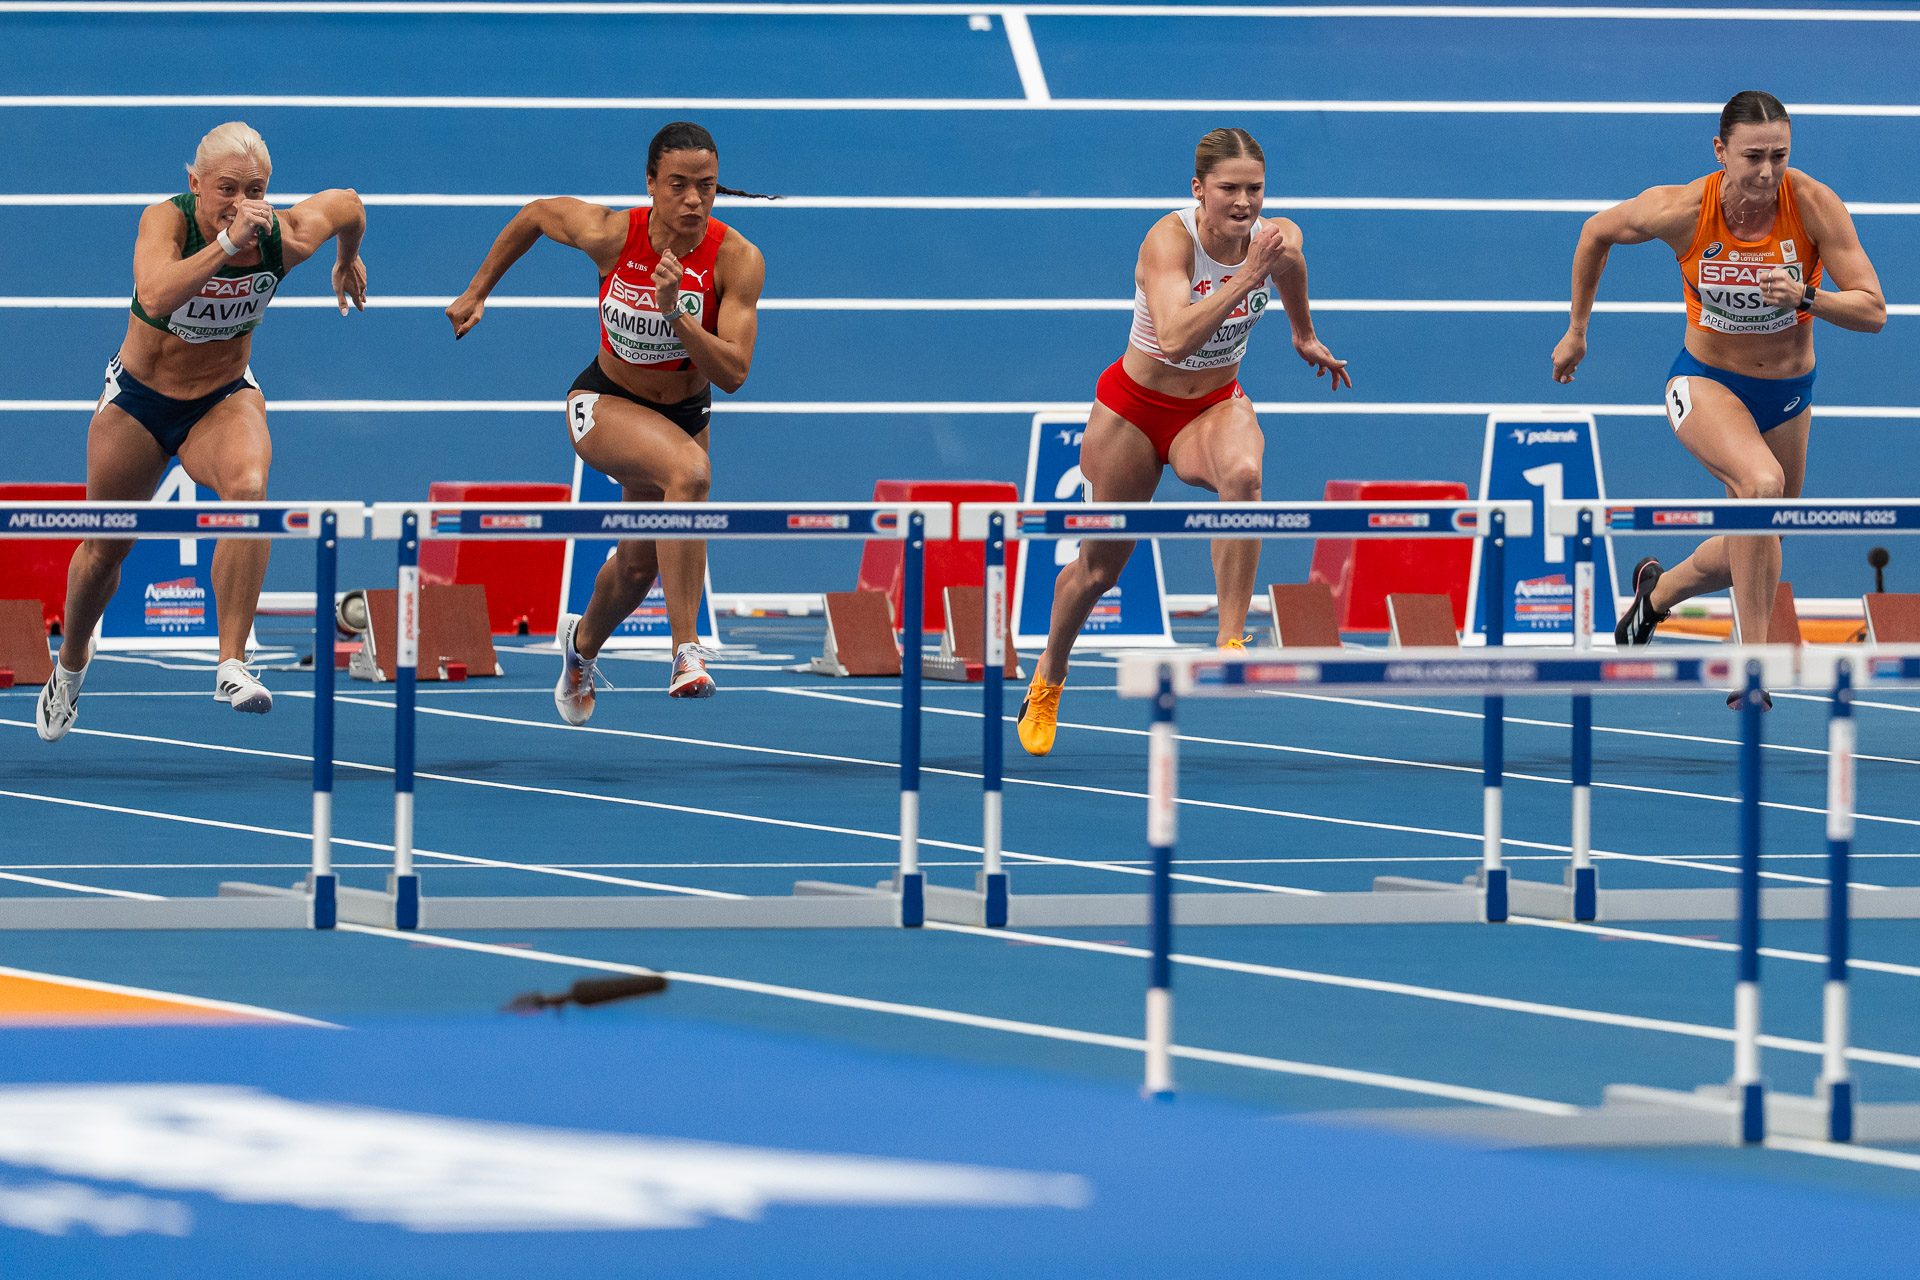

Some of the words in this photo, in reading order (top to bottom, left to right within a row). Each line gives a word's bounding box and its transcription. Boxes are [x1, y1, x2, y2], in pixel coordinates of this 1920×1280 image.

[634, 263, 648, 272] UBS
[201, 280, 250, 296] PAR
[612, 281, 660, 309] SPA
[1193, 280, 1211, 295] 4F
[187, 299, 259, 321] LAVIN
[1726, 313, 1745, 322] RUN
[603, 302, 677, 338] KAMBUN
[1704, 314, 1770, 332] APELDOORN
[1772, 314, 1795, 330] 2025
[194, 327, 214, 335] RUN
[621, 337, 640, 349] RUN
[667, 351, 687, 359] 202
[1195, 350, 1215, 358] RUN
[1672, 389, 1685, 419] 3
[575, 401, 586, 433] 5
[1522, 462, 1565, 563] 1
[1771, 510, 1860, 525] APELDOORN
[1863, 510, 1897, 525] 2025
[8, 513, 100, 528] APELDOORN
[102, 513, 138, 528] 2025
[601, 514, 692, 529] APELDOORN
[694, 514, 729, 529] 2025
[1184, 514, 1275, 529] APELDOORN
[1275, 514, 1311, 529] 2025
